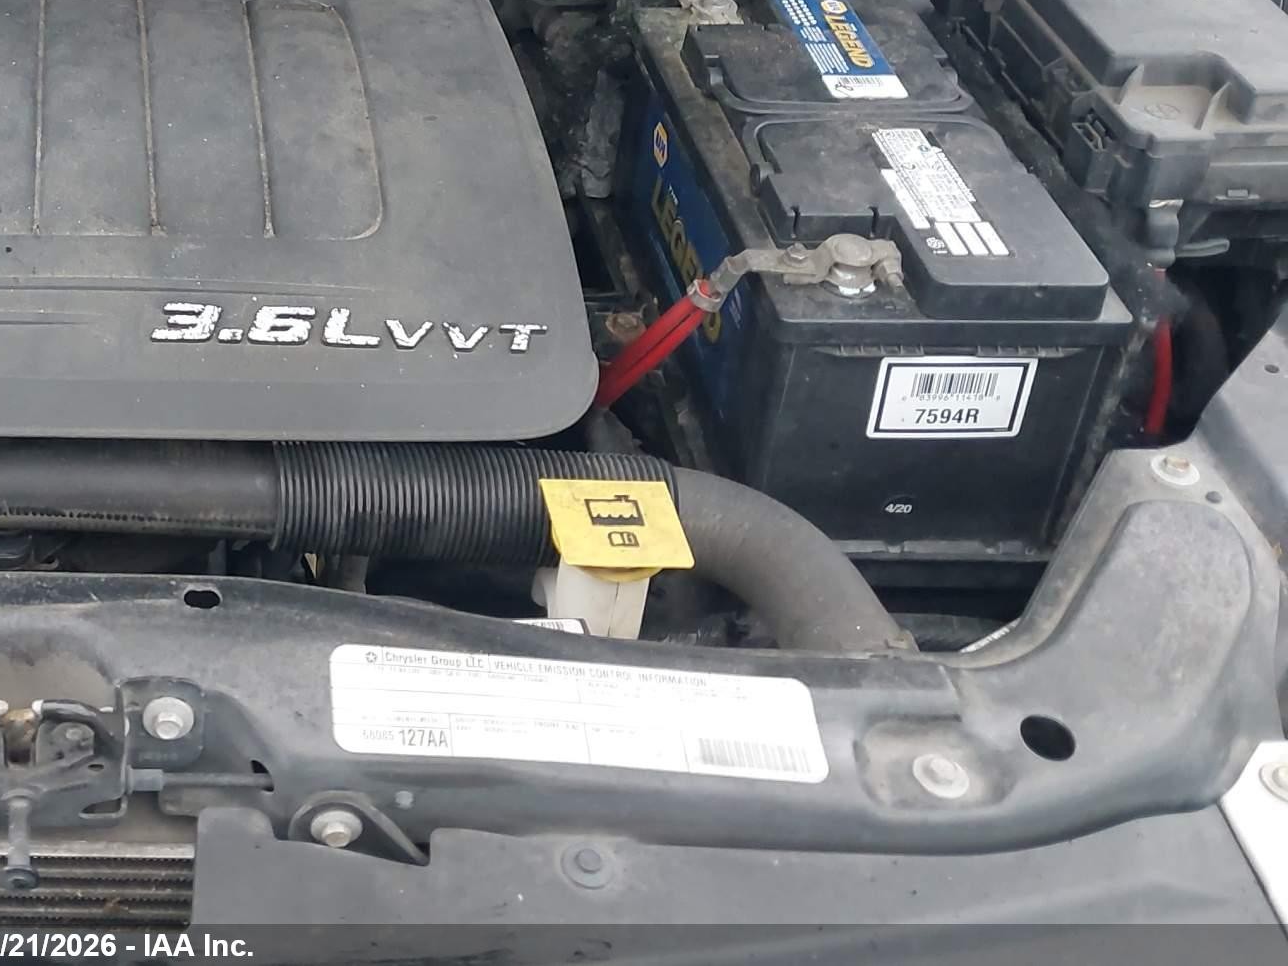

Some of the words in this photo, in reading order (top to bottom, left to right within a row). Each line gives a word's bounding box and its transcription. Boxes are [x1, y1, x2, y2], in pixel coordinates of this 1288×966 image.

[823, 14, 875, 68] LEGEND
[914, 408, 980, 424] 7594R
[884, 502, 913, 514] 4/20
[385, 651, 428, 667] Chrysler
[431, 654, 462, 669] Group
[465, 656, 484, 669] LLC
[494, 660, 534, 673] VEHICLE
[538, 664, 586, 677] EMISSION
[590, 668, 632, 681] CONTROL
[638, 673, 707, 687] INFORMATION
[398, 728, 449, 748] 127AA
